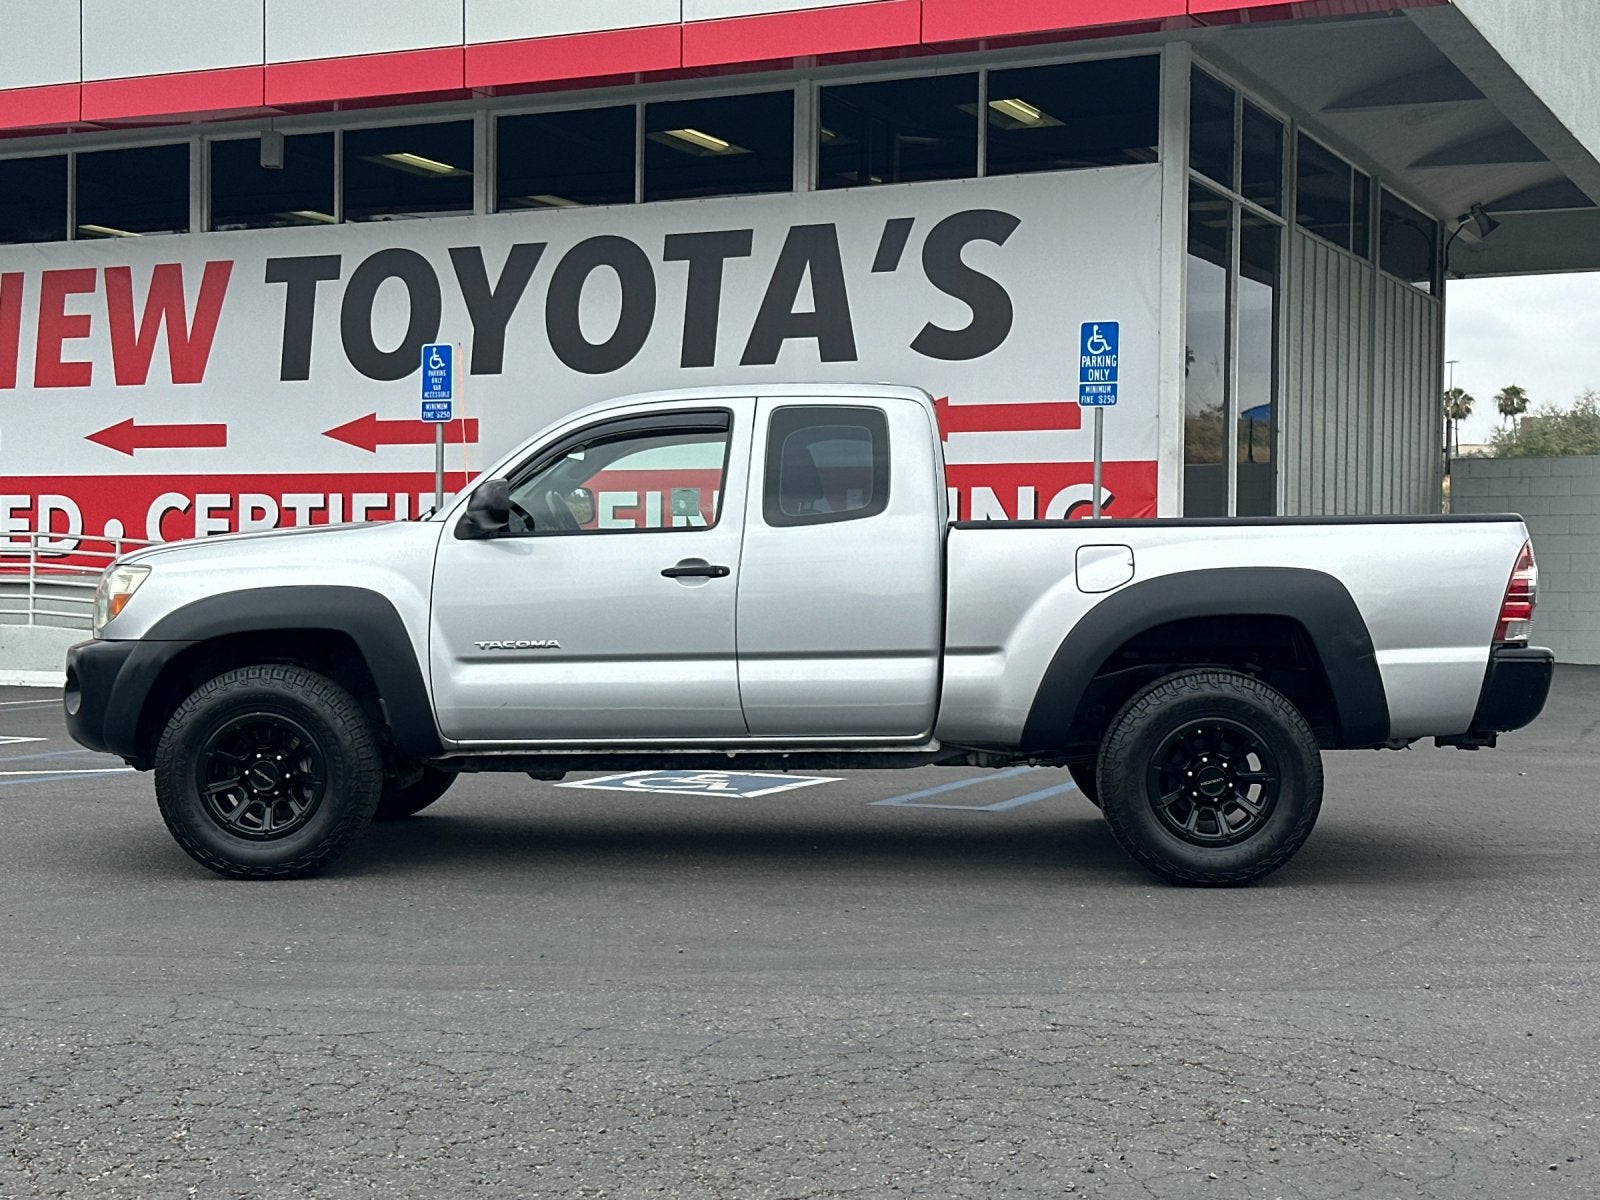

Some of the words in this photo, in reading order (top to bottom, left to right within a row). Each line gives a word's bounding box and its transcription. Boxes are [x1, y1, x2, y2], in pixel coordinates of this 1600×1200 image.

[264, 209, 1021, 382] TOYOTA'S
[1082, 355, 1117, 367] PARKING
[1088, 369, 1110, 381] ONLY
[1081, 396, 1094, 404] FINE
[1098, 395, 1116, 404] $250
[474, 640, 561, 650] TACOMA
